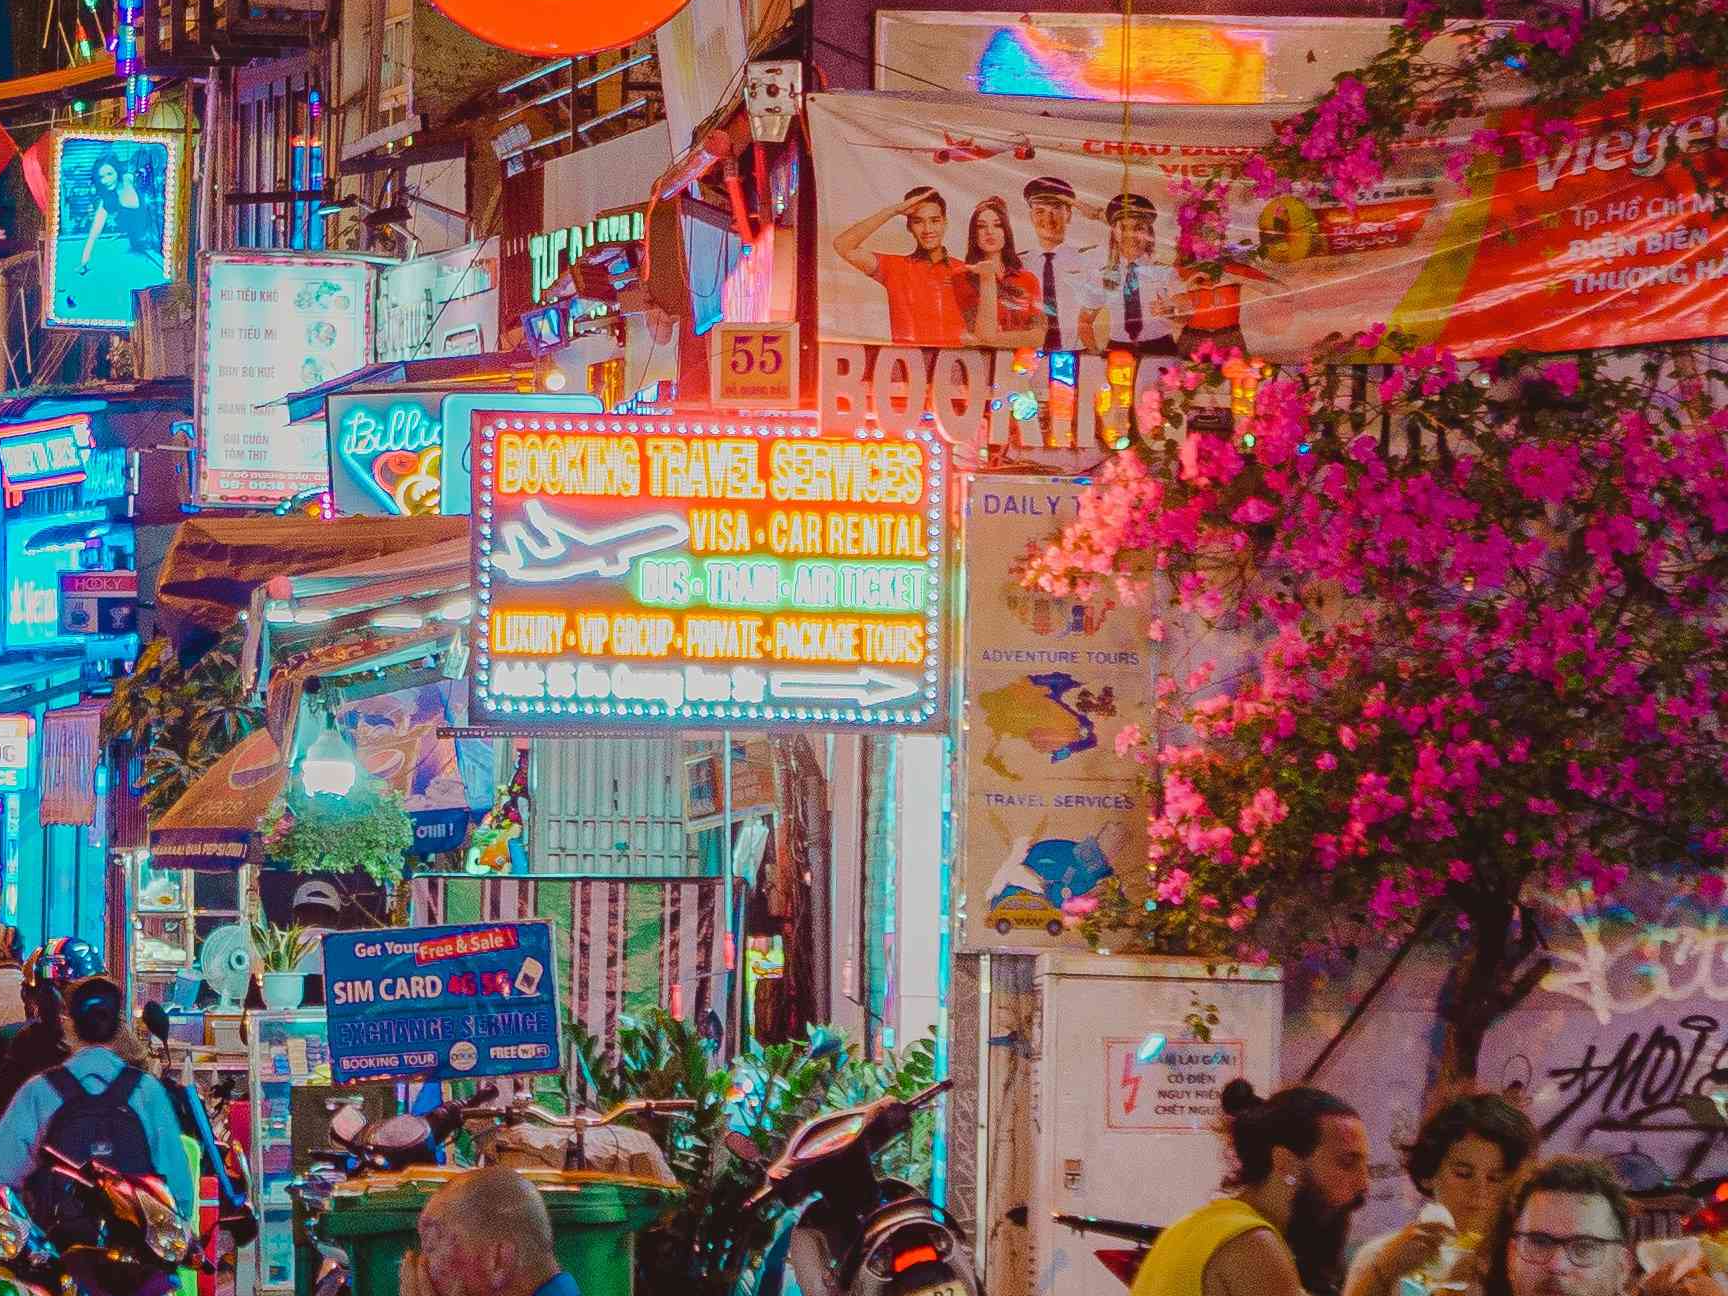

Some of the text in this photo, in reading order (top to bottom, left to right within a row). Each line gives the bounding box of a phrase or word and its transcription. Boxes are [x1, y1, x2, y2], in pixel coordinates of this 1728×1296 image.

[730, 335, 784, 375] 55
[498, 435, 924, 504] BOOKING TRAVEL SERVICES
[983, 494, 1060, 516] DAILY
[689, 508, 929, 557] VISA CAR RENTAL
[793, 565, 836, 608] AIR
[840, 566, 928, 610] TICKET
[492, 612, 924, 664] LUXURY VIP GROUP PRIVATE PACKAGE TOURS
[981, 649, 1140, 666] ADVENTURE TOURS
[984, 793, 1136, 811] TRAVEL SERVICES
[354, 935, 505, 961] Get Your Free & Sale
[332, 979, 375, 1004] SIM
[378, 975, 443, 1001] CARD
[334, 1011, 549, 1049] EXCHANGE SERVICE
[342, 1056, 400, 1070] BOOKING
[489, 1045, 517, 1059] FREE
